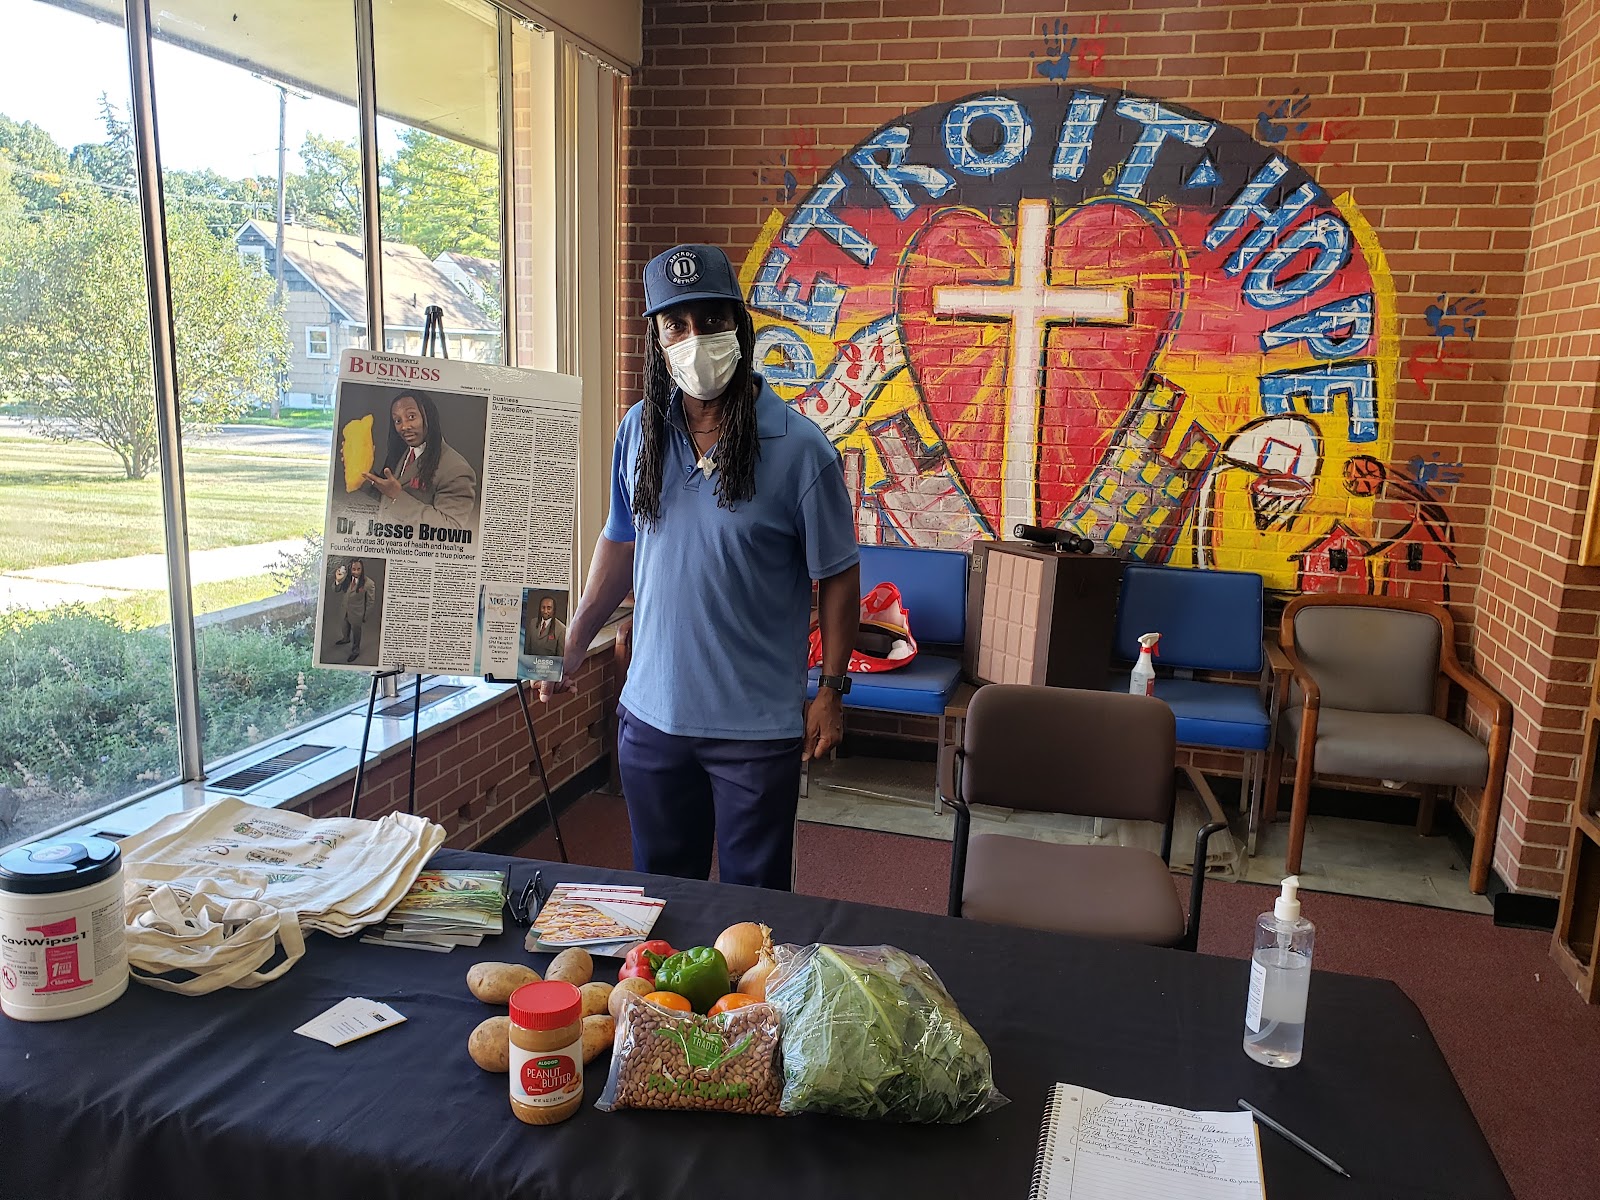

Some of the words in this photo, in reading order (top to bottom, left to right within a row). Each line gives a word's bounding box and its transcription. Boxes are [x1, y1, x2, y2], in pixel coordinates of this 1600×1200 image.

[669, 251, 697, 264] DETROIT
[749, 88, 1218, 387] DETROIT
[1204, 155, 1381, 444] HOPE
[673, 274, 700, 285] DETROIT
[348, 356, 441, 382] BUSINESS
[492, 396, 519, 404] business
[337, 516, 360, 536] Dr.
[366, 519, 414, 540] Jesse
[419, 523, 473, 545] Brown
[330, 543, 356, 552] Founder
[364, 545, 385, 554] Detroit
[385, 547, 413, 556] Wholistic
[414, 549, 434, 558] Center
[440, 551, 453, 559] true
[453, 552, 476, 560] pioneer
[344, 537, 376, 545] celebrates
[376, 538, 385, 546] 30
[411, 541, 430, 549] health
[442, 543, 464, 553] healing
[533, 657, 554, 665] Jesse
[692, 1037, 719, 1055] TRADER
[527, 1066, 561, 1079] PEANUT
[542, 1072, 571, 1088] BUTTER
